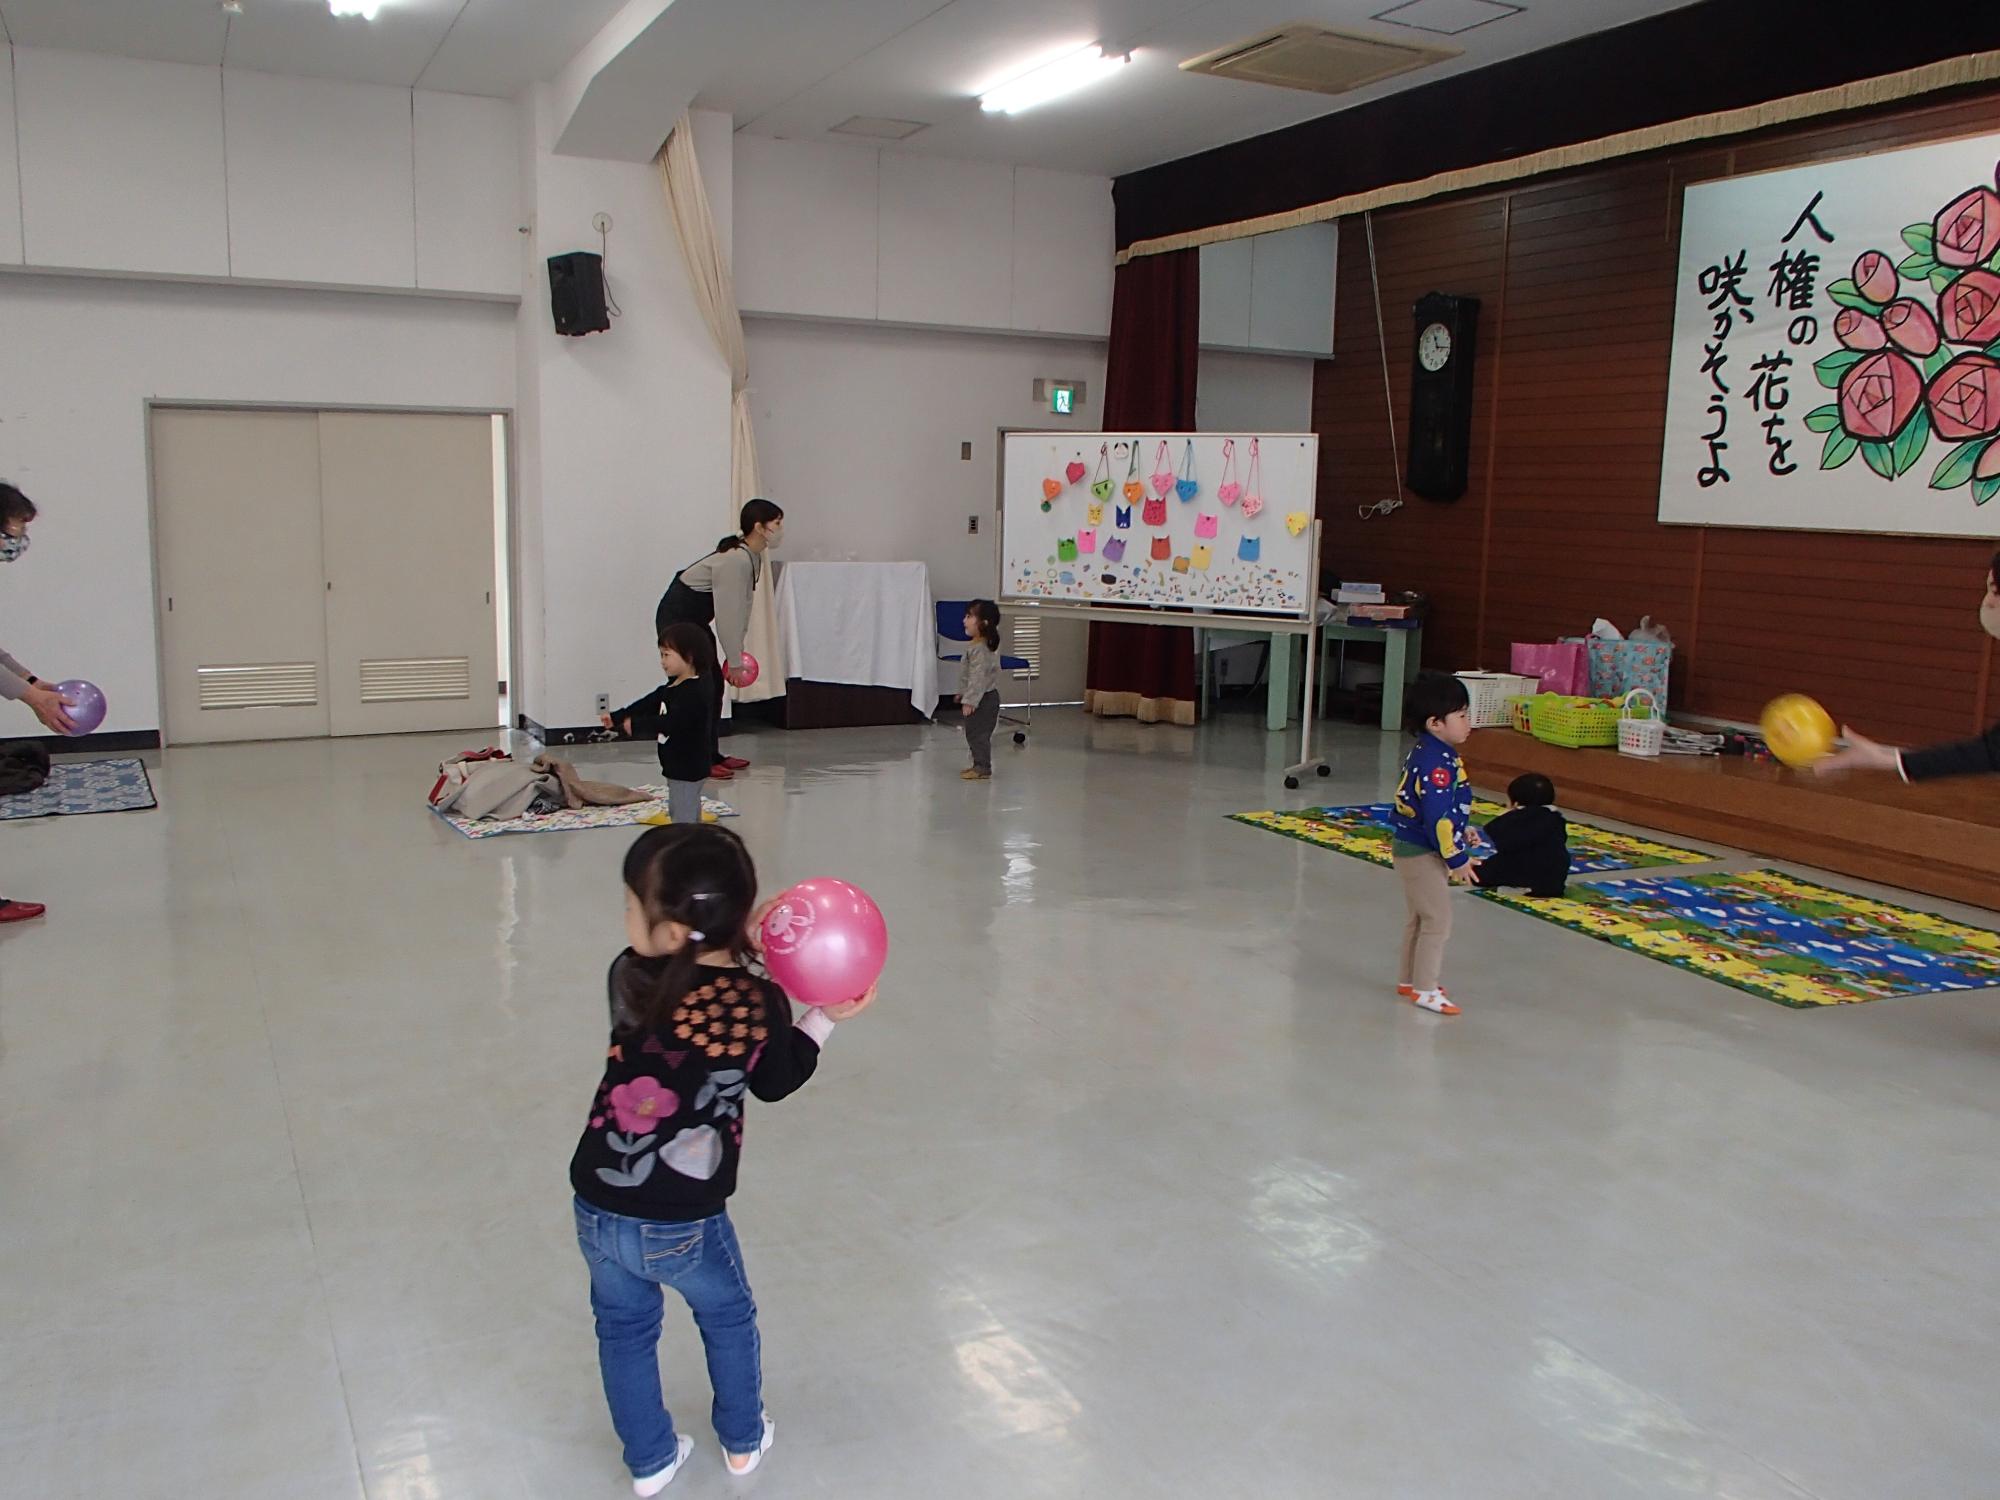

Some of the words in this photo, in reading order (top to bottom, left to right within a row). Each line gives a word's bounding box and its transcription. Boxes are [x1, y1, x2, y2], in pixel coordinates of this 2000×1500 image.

[1698, 249, 1754, 488] 咲かそうよ
[1743, 190, 1834, 476] 人権の花を
